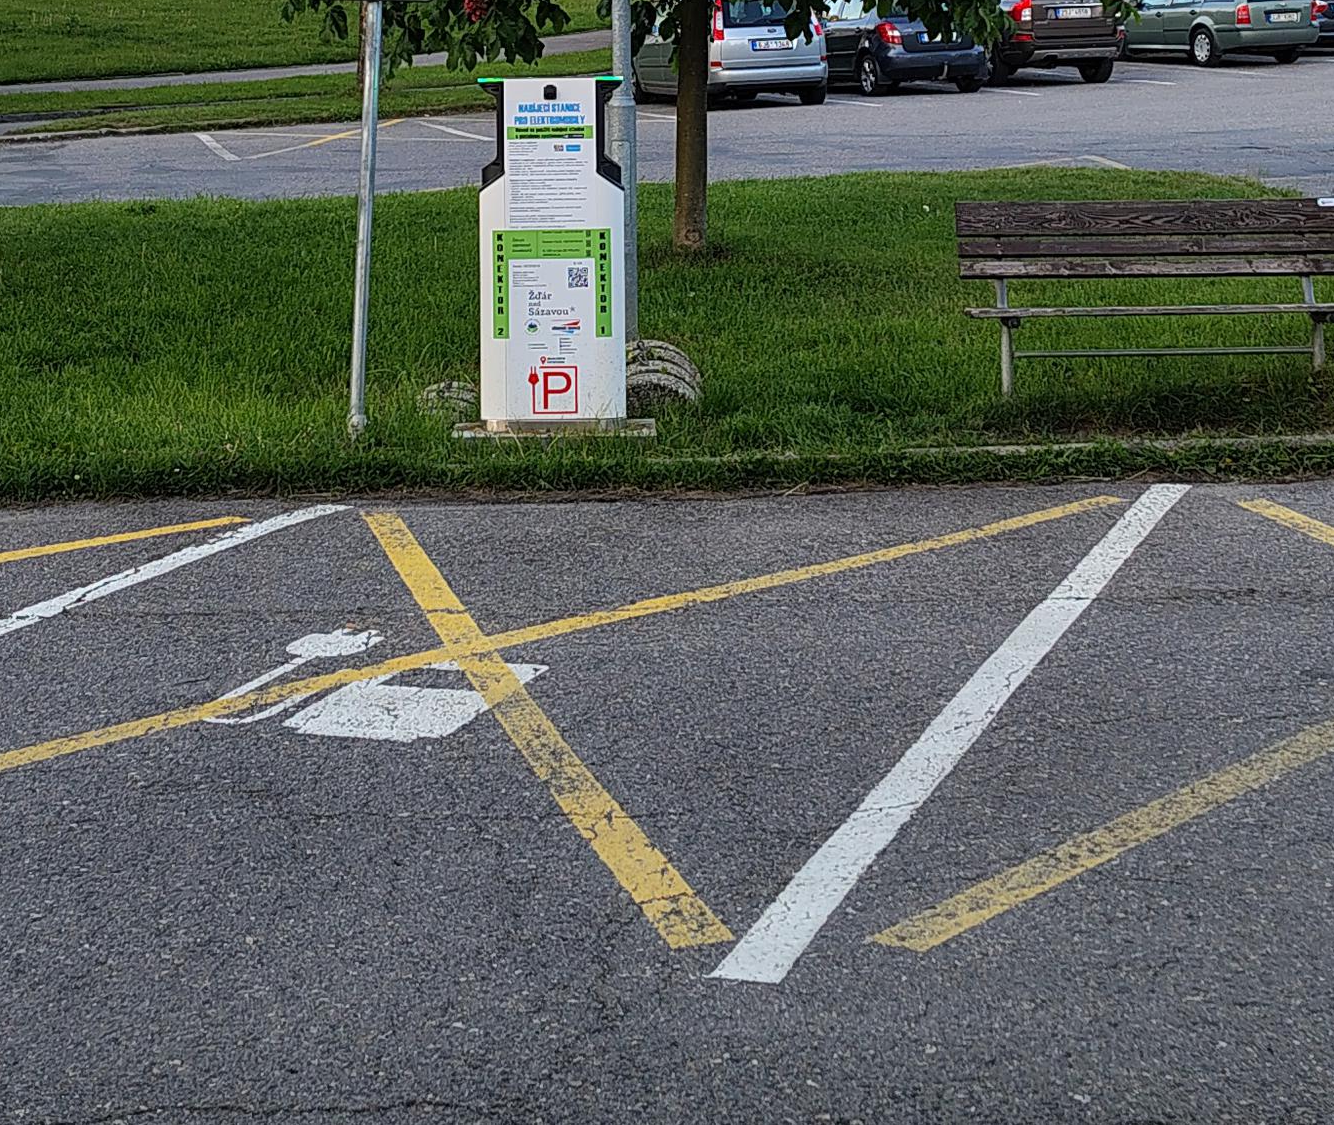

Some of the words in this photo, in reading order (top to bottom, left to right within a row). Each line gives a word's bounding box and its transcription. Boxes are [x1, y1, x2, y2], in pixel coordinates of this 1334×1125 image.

[528, 307, 569, 316] Sázavou
[497, 328, 504, 336] 2
[600, 325, 605, 335] 1
[543, 372, 572, 410] P
